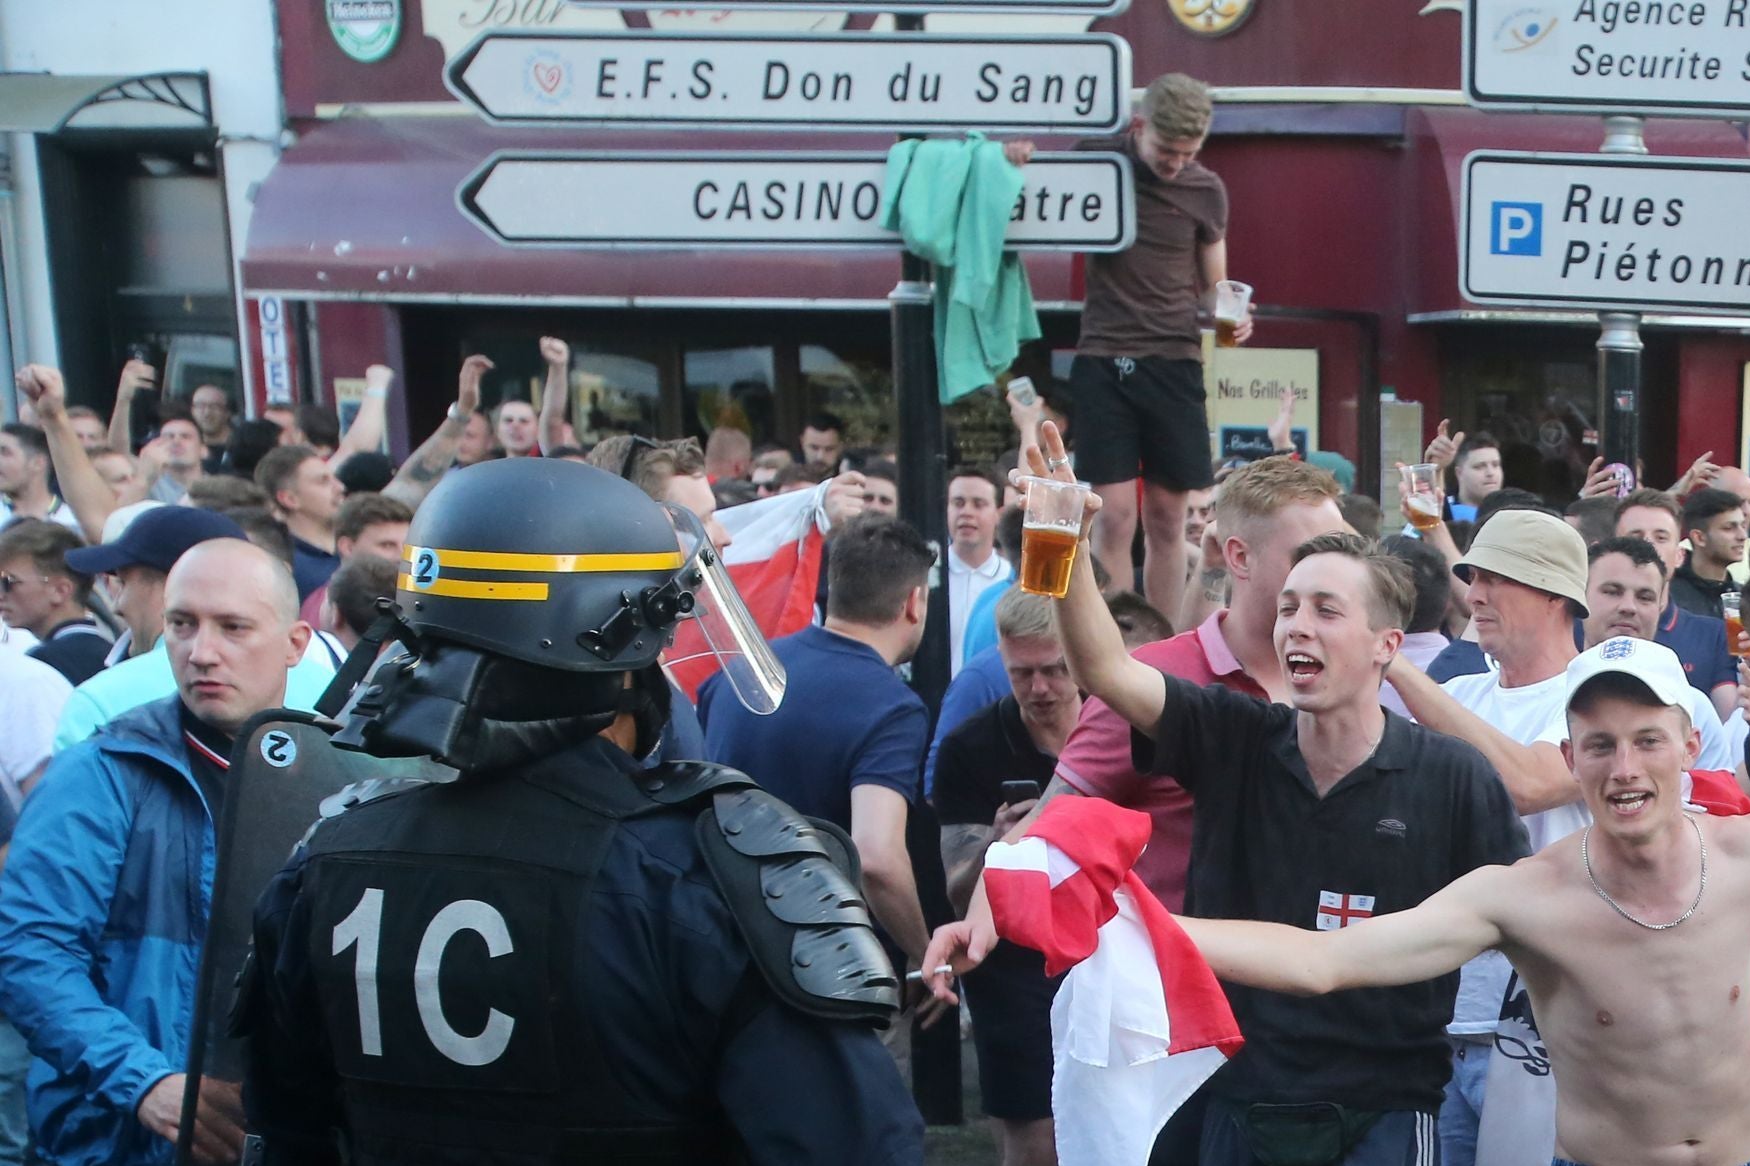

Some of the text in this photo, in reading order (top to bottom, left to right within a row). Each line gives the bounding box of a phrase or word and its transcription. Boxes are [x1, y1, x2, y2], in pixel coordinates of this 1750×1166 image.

[1573, 0, 1705, 33] Agence
[1572, 44, 1722, 81] Securite
[596, 59, 728, 100] E.F.S.
[761, 61, 853, 101] Don
[888, 62, 942, 102] du
[976, 62, 1098, 116] Sang
[693, 180, 879, 221] CASINO
[1561, 183, 1684, 227] Rues
[1217, 379, 1244, 399] Nos
[416, 554, 434, 583] 2
[267, 734, 290, 762] 2
[332, 888, 516, 1066] 1C
